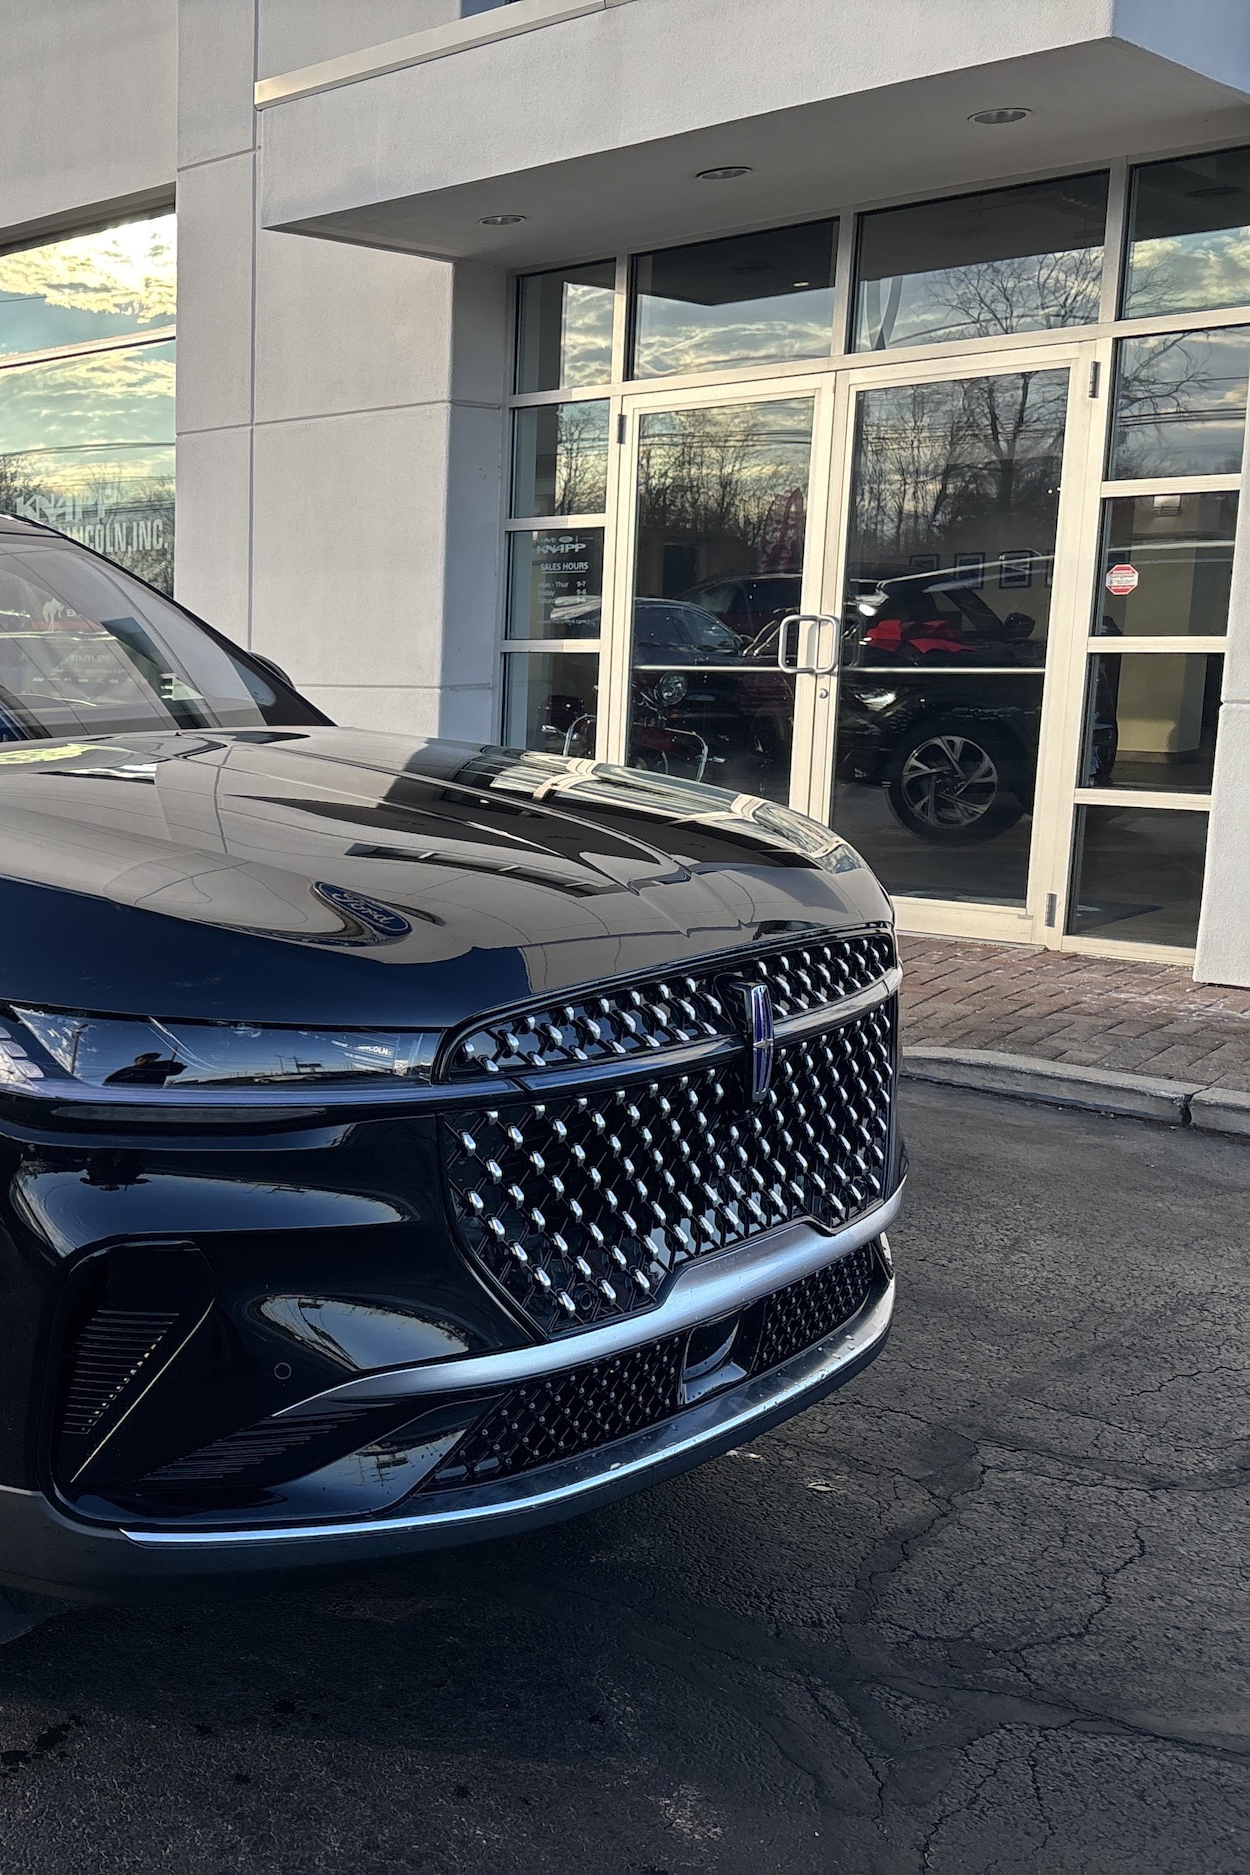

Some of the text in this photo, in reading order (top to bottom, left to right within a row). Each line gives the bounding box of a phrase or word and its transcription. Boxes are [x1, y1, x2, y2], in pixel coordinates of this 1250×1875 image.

[537, 543, 587, 554] KNAPP
[540, 561, 589, 571] SALES HOURS
